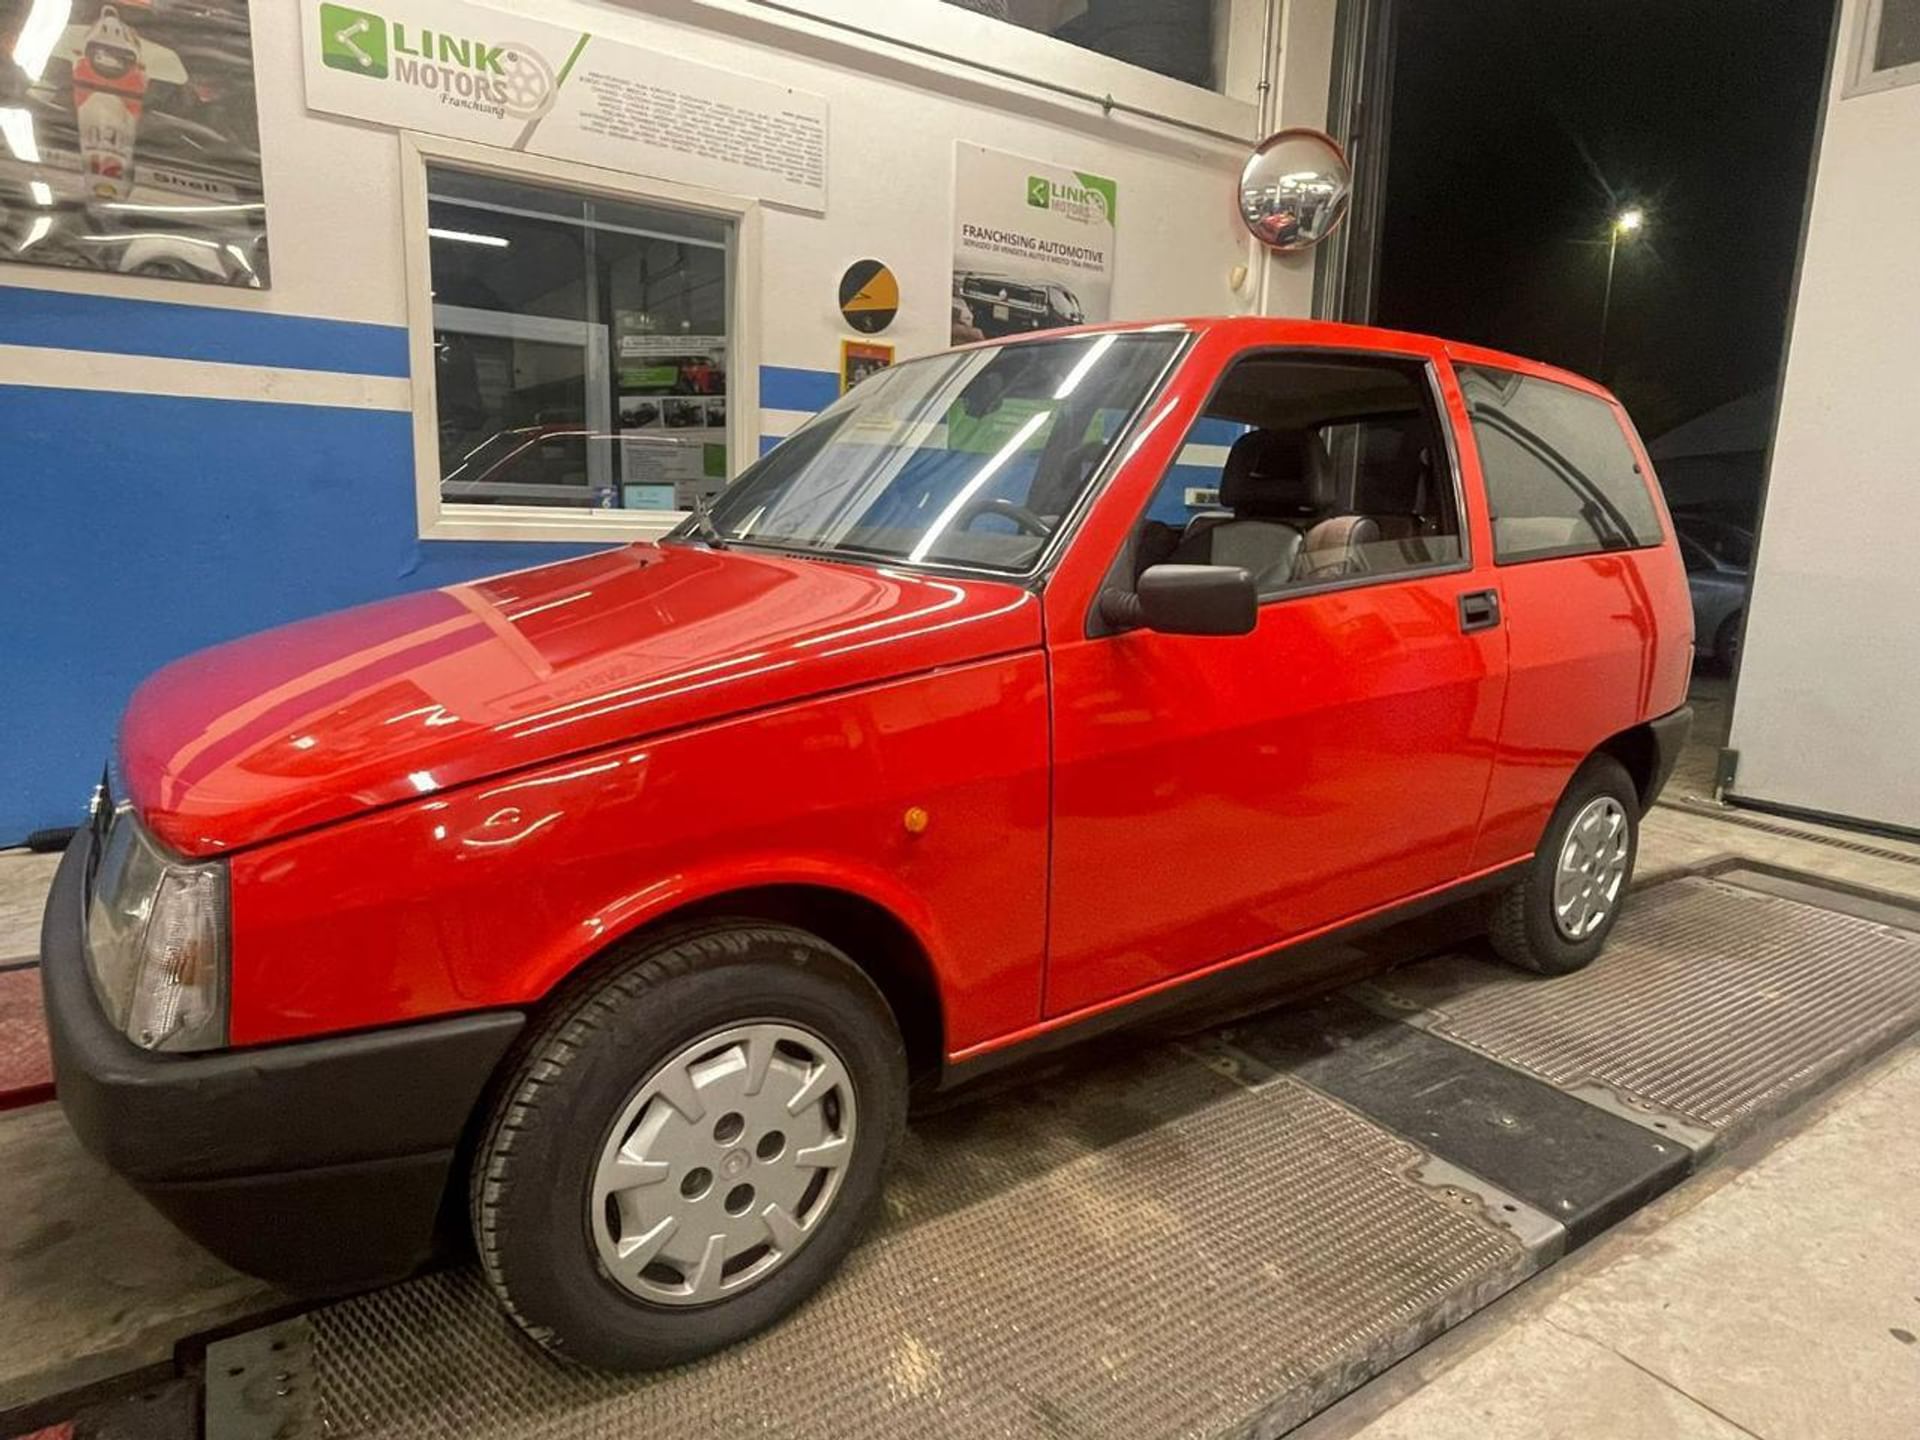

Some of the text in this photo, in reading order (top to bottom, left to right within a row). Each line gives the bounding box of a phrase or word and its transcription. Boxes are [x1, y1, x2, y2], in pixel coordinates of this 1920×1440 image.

[393, 22, 506, 76] LINK
[395, 57, 508, 105] MOTORS
[153, 172, 219, 193] Shell
[1051, 182, 1090, 205] LINK
[962, 223, 1104, 264] FRANCHISING AUTOMOTIVE
